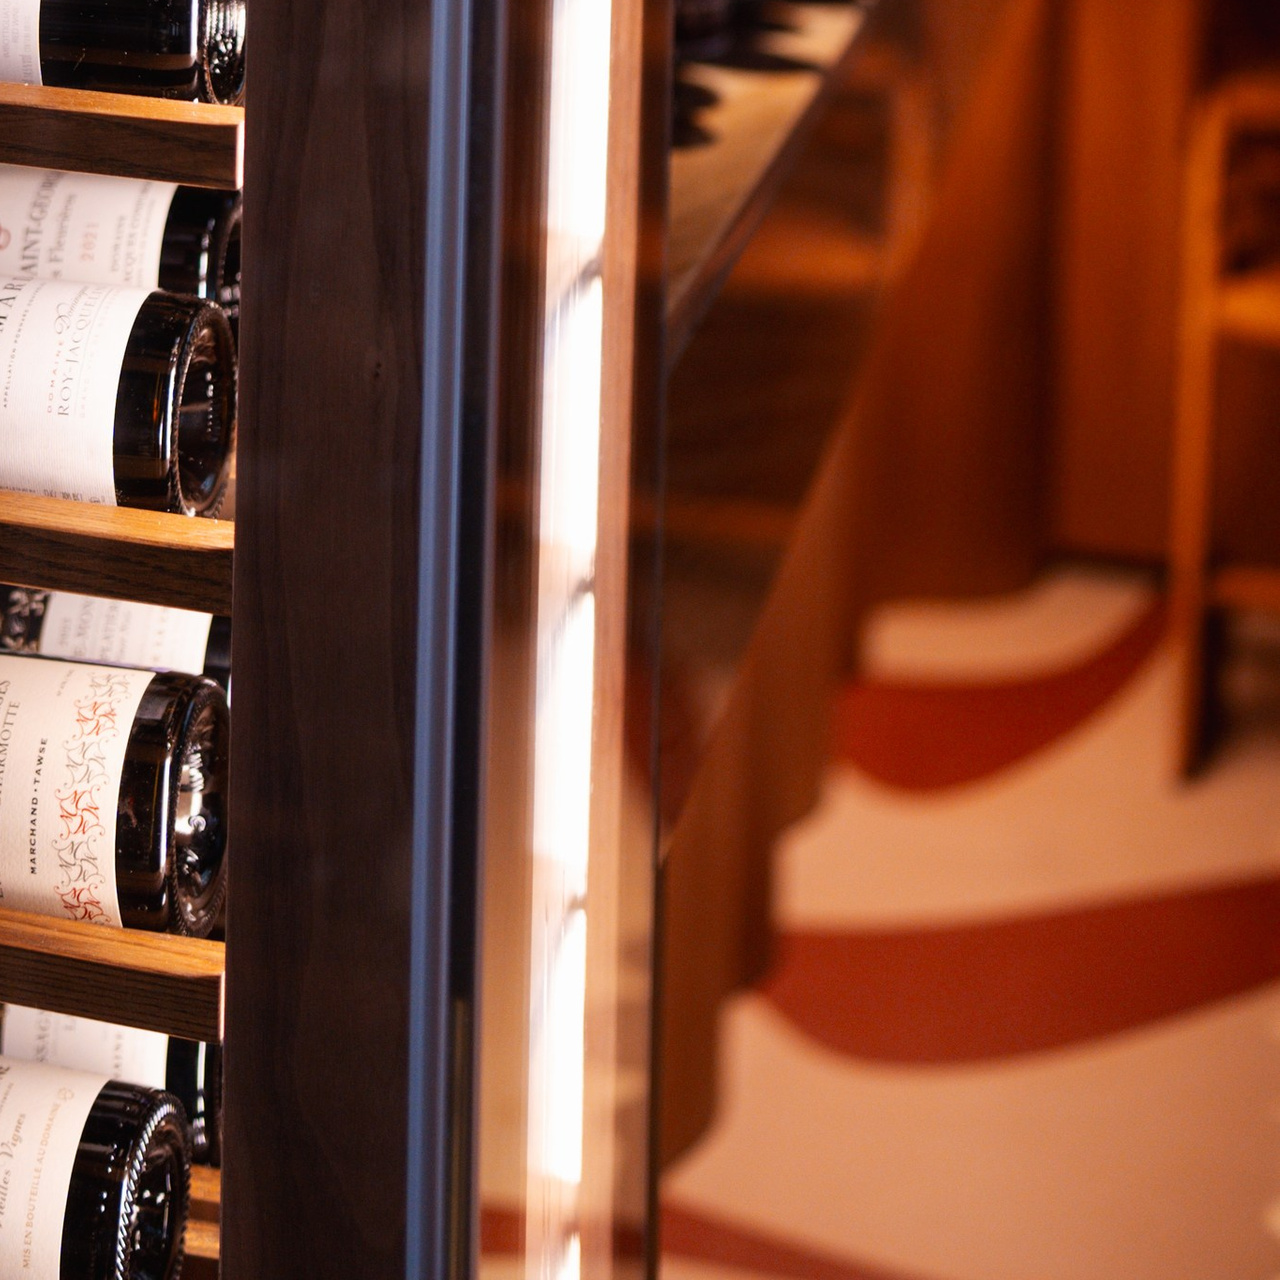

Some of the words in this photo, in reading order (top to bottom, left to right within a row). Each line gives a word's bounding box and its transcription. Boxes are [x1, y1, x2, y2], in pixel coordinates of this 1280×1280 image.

[47, 340, 64, 414] DOMAINE
[33, 737, 48, 785] TAWSE
[29, 797, 39, 875] MARCHAND
[39, 1103, 60, 1147] DOMAINE
[36, 1147, 46, 1165] AU
[25, 1165, 42, 1228] BOUTEILLE
[22, 1248, 31, 1269] MIS
[23, 1230, 32, 1246] EN
